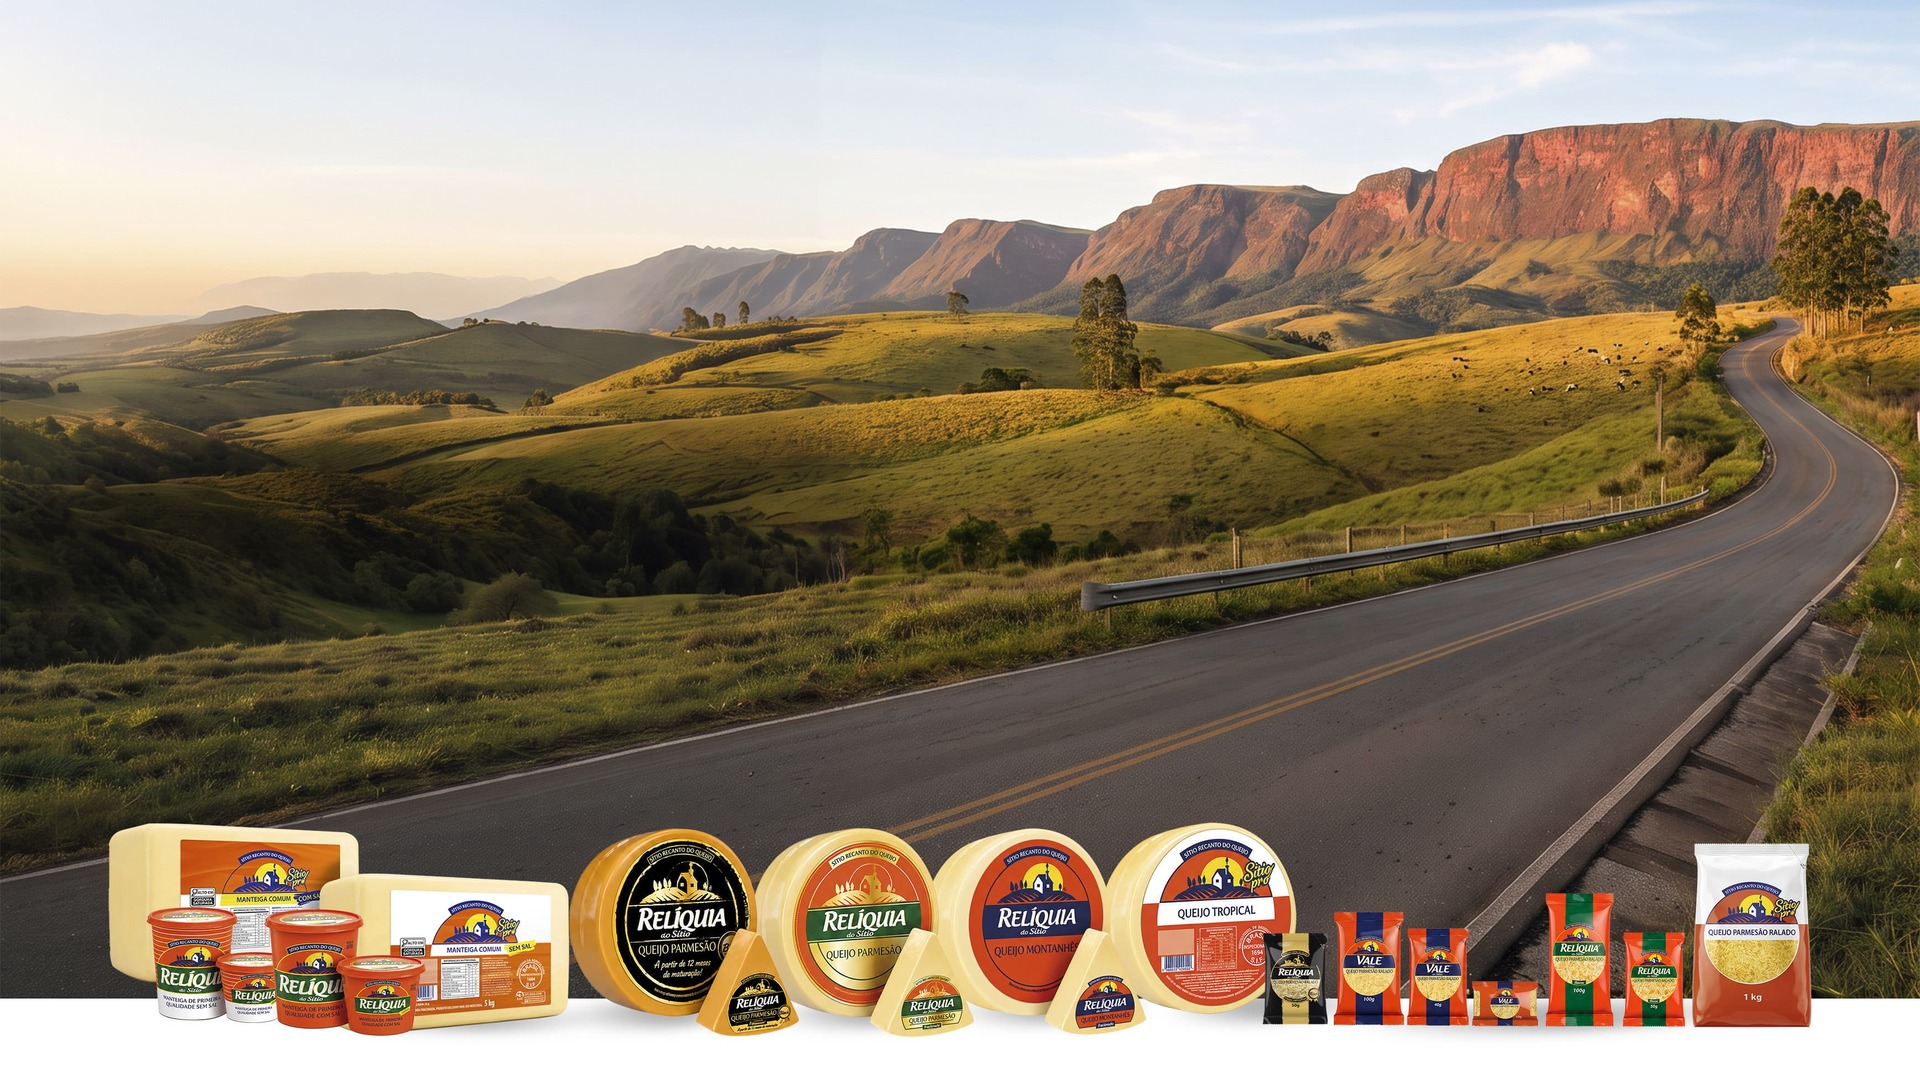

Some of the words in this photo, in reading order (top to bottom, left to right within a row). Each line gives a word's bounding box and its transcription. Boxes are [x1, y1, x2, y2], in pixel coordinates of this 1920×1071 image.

[662, 848, 685, 856] RECANTO
[1198, 842, 1222, 851] RECANTO
[1231, 845, 1249, 855] QUEIJO
[845, 850, 869, 859] RECANTO
[1178, 908, 1210, 919] QUEIJO
[1212, 905, 1256, 916] TROPICAL
[637, 906, 726, 934] RELÍQUIA
[823, 908, 906, 937] RELÍQUIA
[998, 907, 1076, 929] RELÍQUIA
[1246, 933, 1264, 943] BRAS
[638, 941, 669, 957] QUEIJO
[671, 940, 716, 954] PARMESÃO
[826, 945, 855, 960] QUEIJO
[858, 944, 901, 956] PARMESÃO
[994, 943, 1024, 957] QUEIJO
[1026, 941, 1079, 954] MONTANHÊS
[1560, 943, 1599, 954] RELÍQUIA
[654, 960, 660, 969] A
[660, 960, 678, 970] partir
[1357, 955, 1383, 965] VALE
[1278, 968, 1314, 977] RELÍQUIA
[1426, 964, 1451, 973] VALE
[1638, 967, 1670, 976] RELÍQUIA
[161, 967, 222, 989] RELÍQUI
[280, 974, 343, 998] RELÍQUI
[163, 995, 187, 1003] MANTEIGA
[235, 990, 275, 1001] RELÍQUIA
[1751, 993, 1762, 1002] kg
[282, 1003, 307, 1012] MANTEIGA
[360, 998, 406, 1011] RELÍQUIA
[488, 999, 495, 1008] kg
[736, 995, 779, 1009] RELÍQUIA
[910, 999, 954, 1012] RELÍQUIA
[1084, 998, 1127, 1011] RELÍQUIA
[731, 1014, 750, 1022] QUEIJO
[909, 1017, 927, 1025] QUEIJO
[928, 1013, 955, 1021] PARMESÃO
[1099, 1012, 1130, 1020] MONTANHÊS
